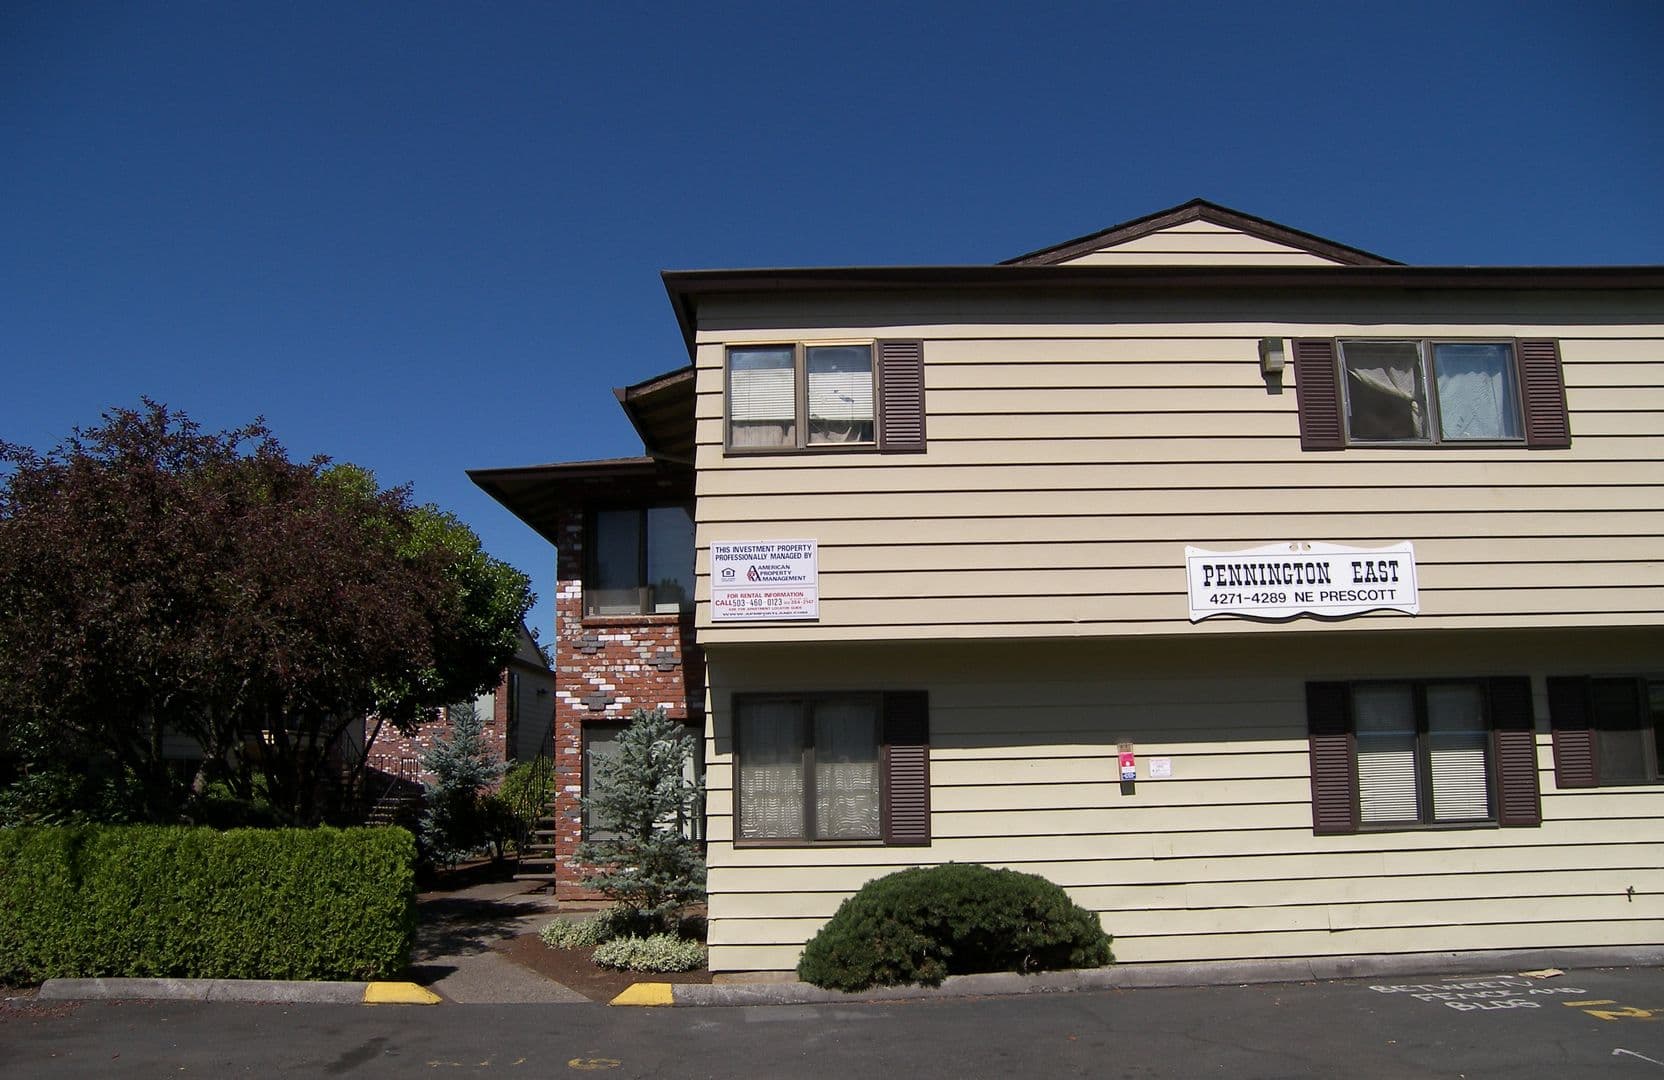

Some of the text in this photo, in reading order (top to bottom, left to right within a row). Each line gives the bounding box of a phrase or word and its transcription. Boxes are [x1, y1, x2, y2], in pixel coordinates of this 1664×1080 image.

[733, 545, 775, 553] INVESTMENT
[777, 544, 812, 552] PROPERTY
[715, 553, 768, 561] PROFESSIONALLY
[770, 552, 802, 560] MANAGED
[1202, 560, 1399, 587] PENNINGTON EAST
[1210, 589, 1397, 605] 4271-4289 NE PRESCOTT
[715, 599, 733, 607] CALL
[1369, 979, 1534, 994] BETWEEN
[1411, 991, 1525, 1002] FENCE
